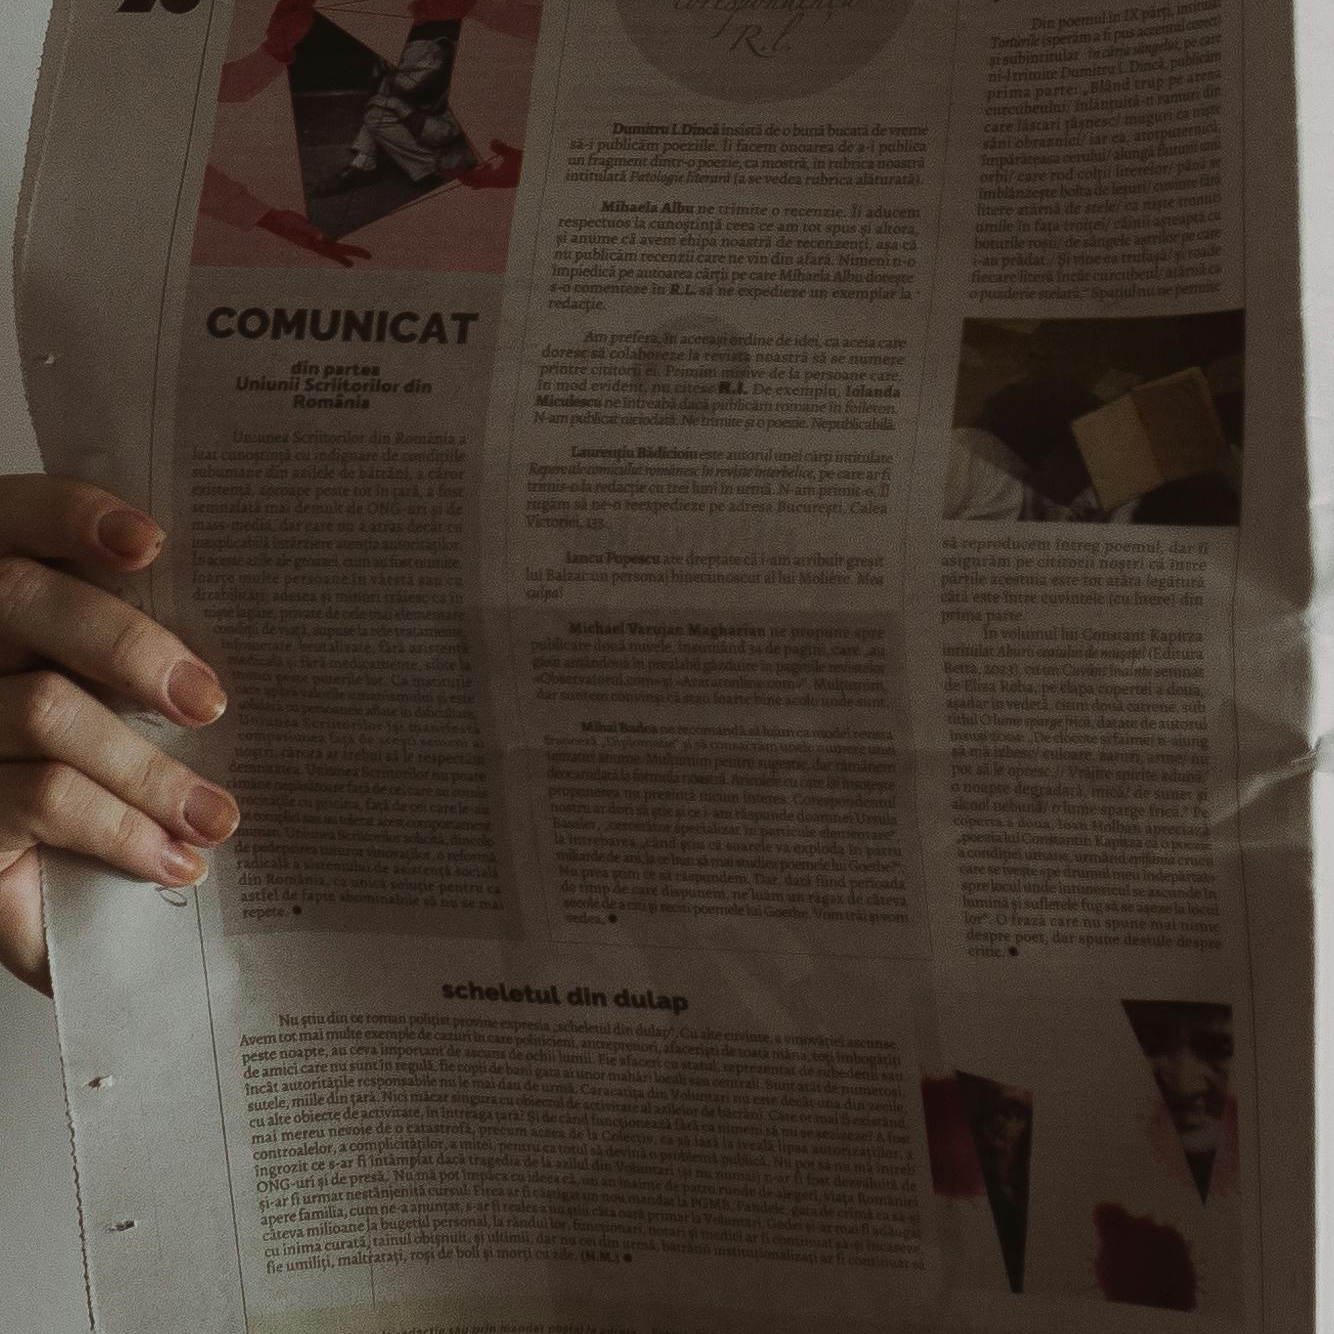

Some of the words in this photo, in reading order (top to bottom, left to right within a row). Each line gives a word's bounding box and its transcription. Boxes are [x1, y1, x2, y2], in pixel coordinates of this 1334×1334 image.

[987, 86, 1031, 102] prima
[1134, 76, 1163, 92] trup
[1168, 75, 1184, 88] pe
[601, 201, 658, 214] Mihaela
[660, 201, 694, 215] Albu
[697, 205, 715, 215] ne
[719, 203, 767, 216] trimite
[772, 207, 781, 216] o
[866, 205, 920, 218] aducem
[207, 306, 479, 345] COMUNICAT
[291, 360, 320, 376] din
[322, 364, 381, 378] partea
[236, 376, 299, 392] Uniunii
[304, 377, 399, 394] Scriitorilor
[403, 378, 432, 394] din
[293, 394, 371, 410] România
[442, 980, 560, 1007] scheletul
[566, 985, 608, 1008] din
[612, 988, 690, 1015] dulap
[239, 1034, 277, 1047] Avem
[279, 1032, 297, 1044] tot
[299, 1030, 323, 1042] mai
[326, 1028, 363, 1041] multe
[242, 1048, 277, 1065] peste
[279, 1046, 328, 1060] noapte,
[331, 1046, 348, 1056] au
[350, 1046, 377, 1056] ceva
[380, 1042, 443, 1057] important
[266, 1260, 283, 1274] fie
[286, 1255, 335, 1272] umiliți,
[338, 1248, 408, 1267] maltratați,
[410, 1249, 435, 1264] roși
[438, 1247, 453, 1260] de
[455, 1245, 480, 1259] boli
[534, 1249, 550, 1259] cu
[580, 1250, 620, 1264] (N.M.)
